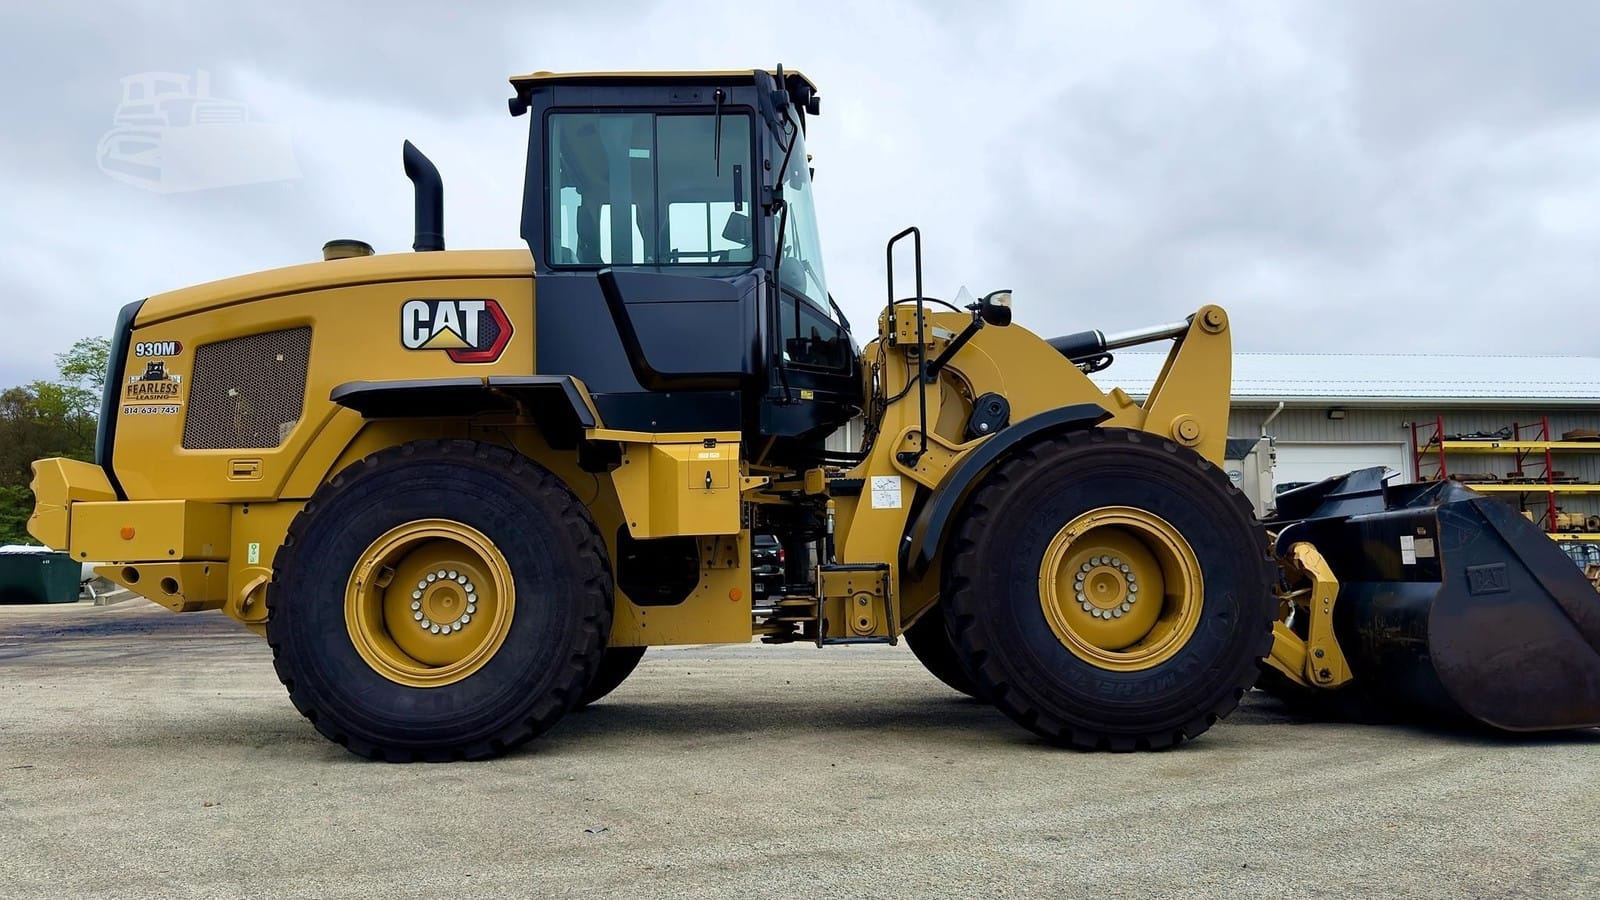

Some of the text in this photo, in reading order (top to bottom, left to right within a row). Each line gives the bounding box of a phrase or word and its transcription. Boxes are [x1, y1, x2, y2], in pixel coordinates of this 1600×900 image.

[402, 300, 486, 349] CAT
[135, 341, 176, 357] 930M
[127, 382, 179, 397] FEARLESS
